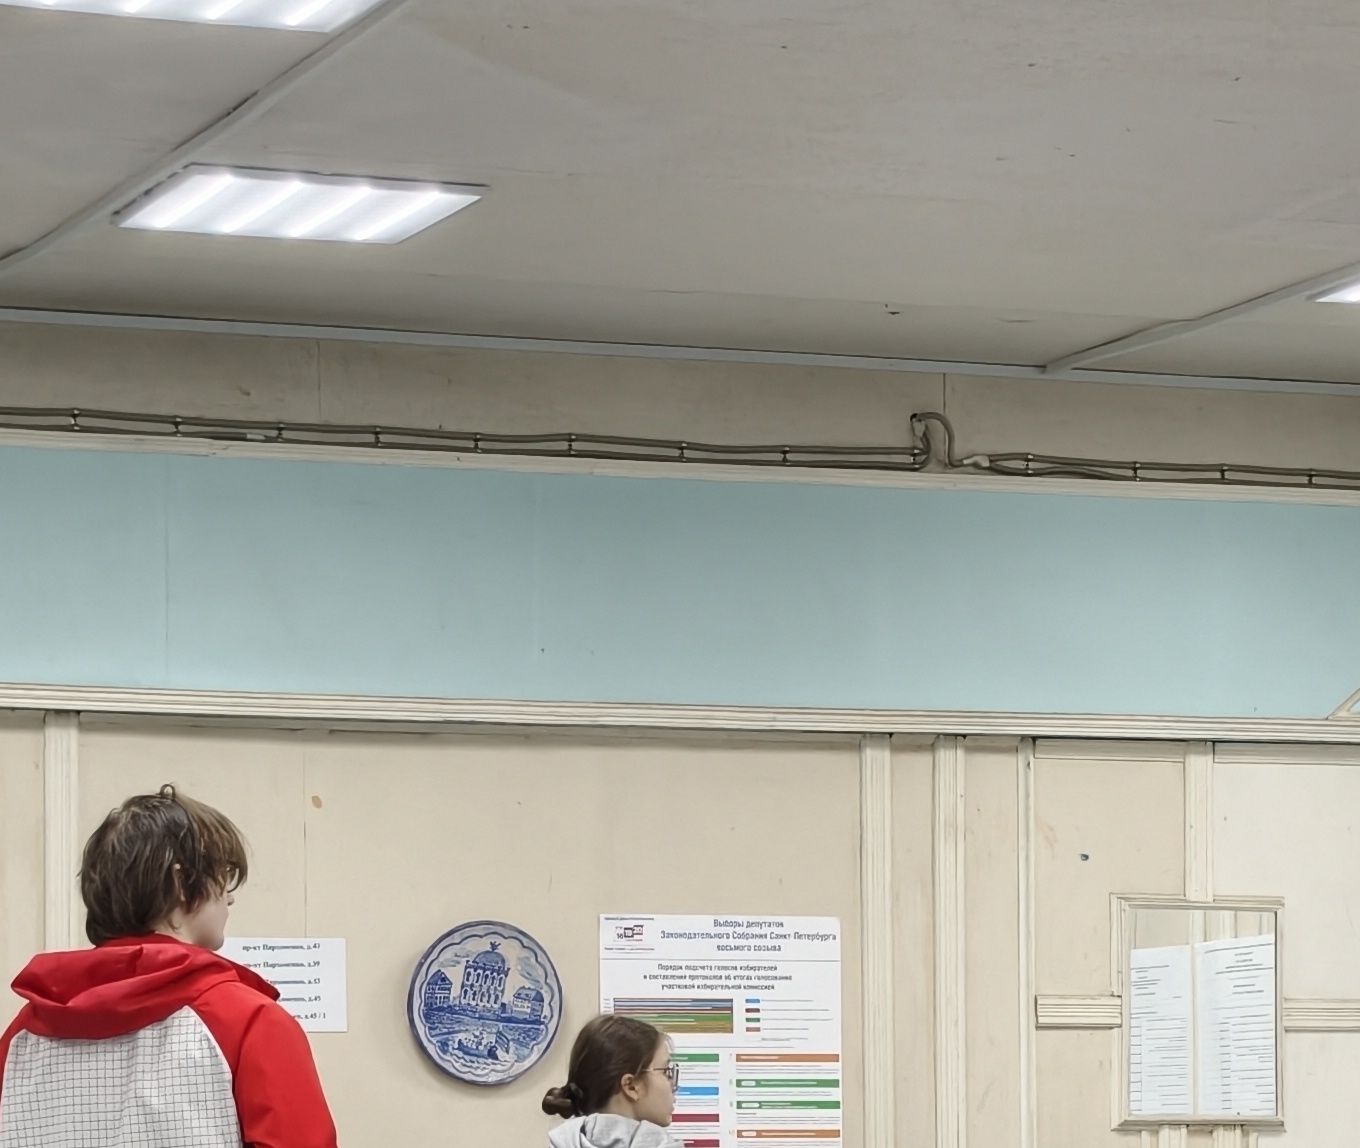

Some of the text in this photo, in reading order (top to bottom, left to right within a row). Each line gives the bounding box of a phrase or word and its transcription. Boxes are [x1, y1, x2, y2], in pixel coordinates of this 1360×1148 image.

[714, 919, 784, 929] Выборы депутатов
[661, 931, 730, 940] Законодательного
[732, 931, 768, 940] Собрания
[717, 944, 782, 952] восьмого созыва
